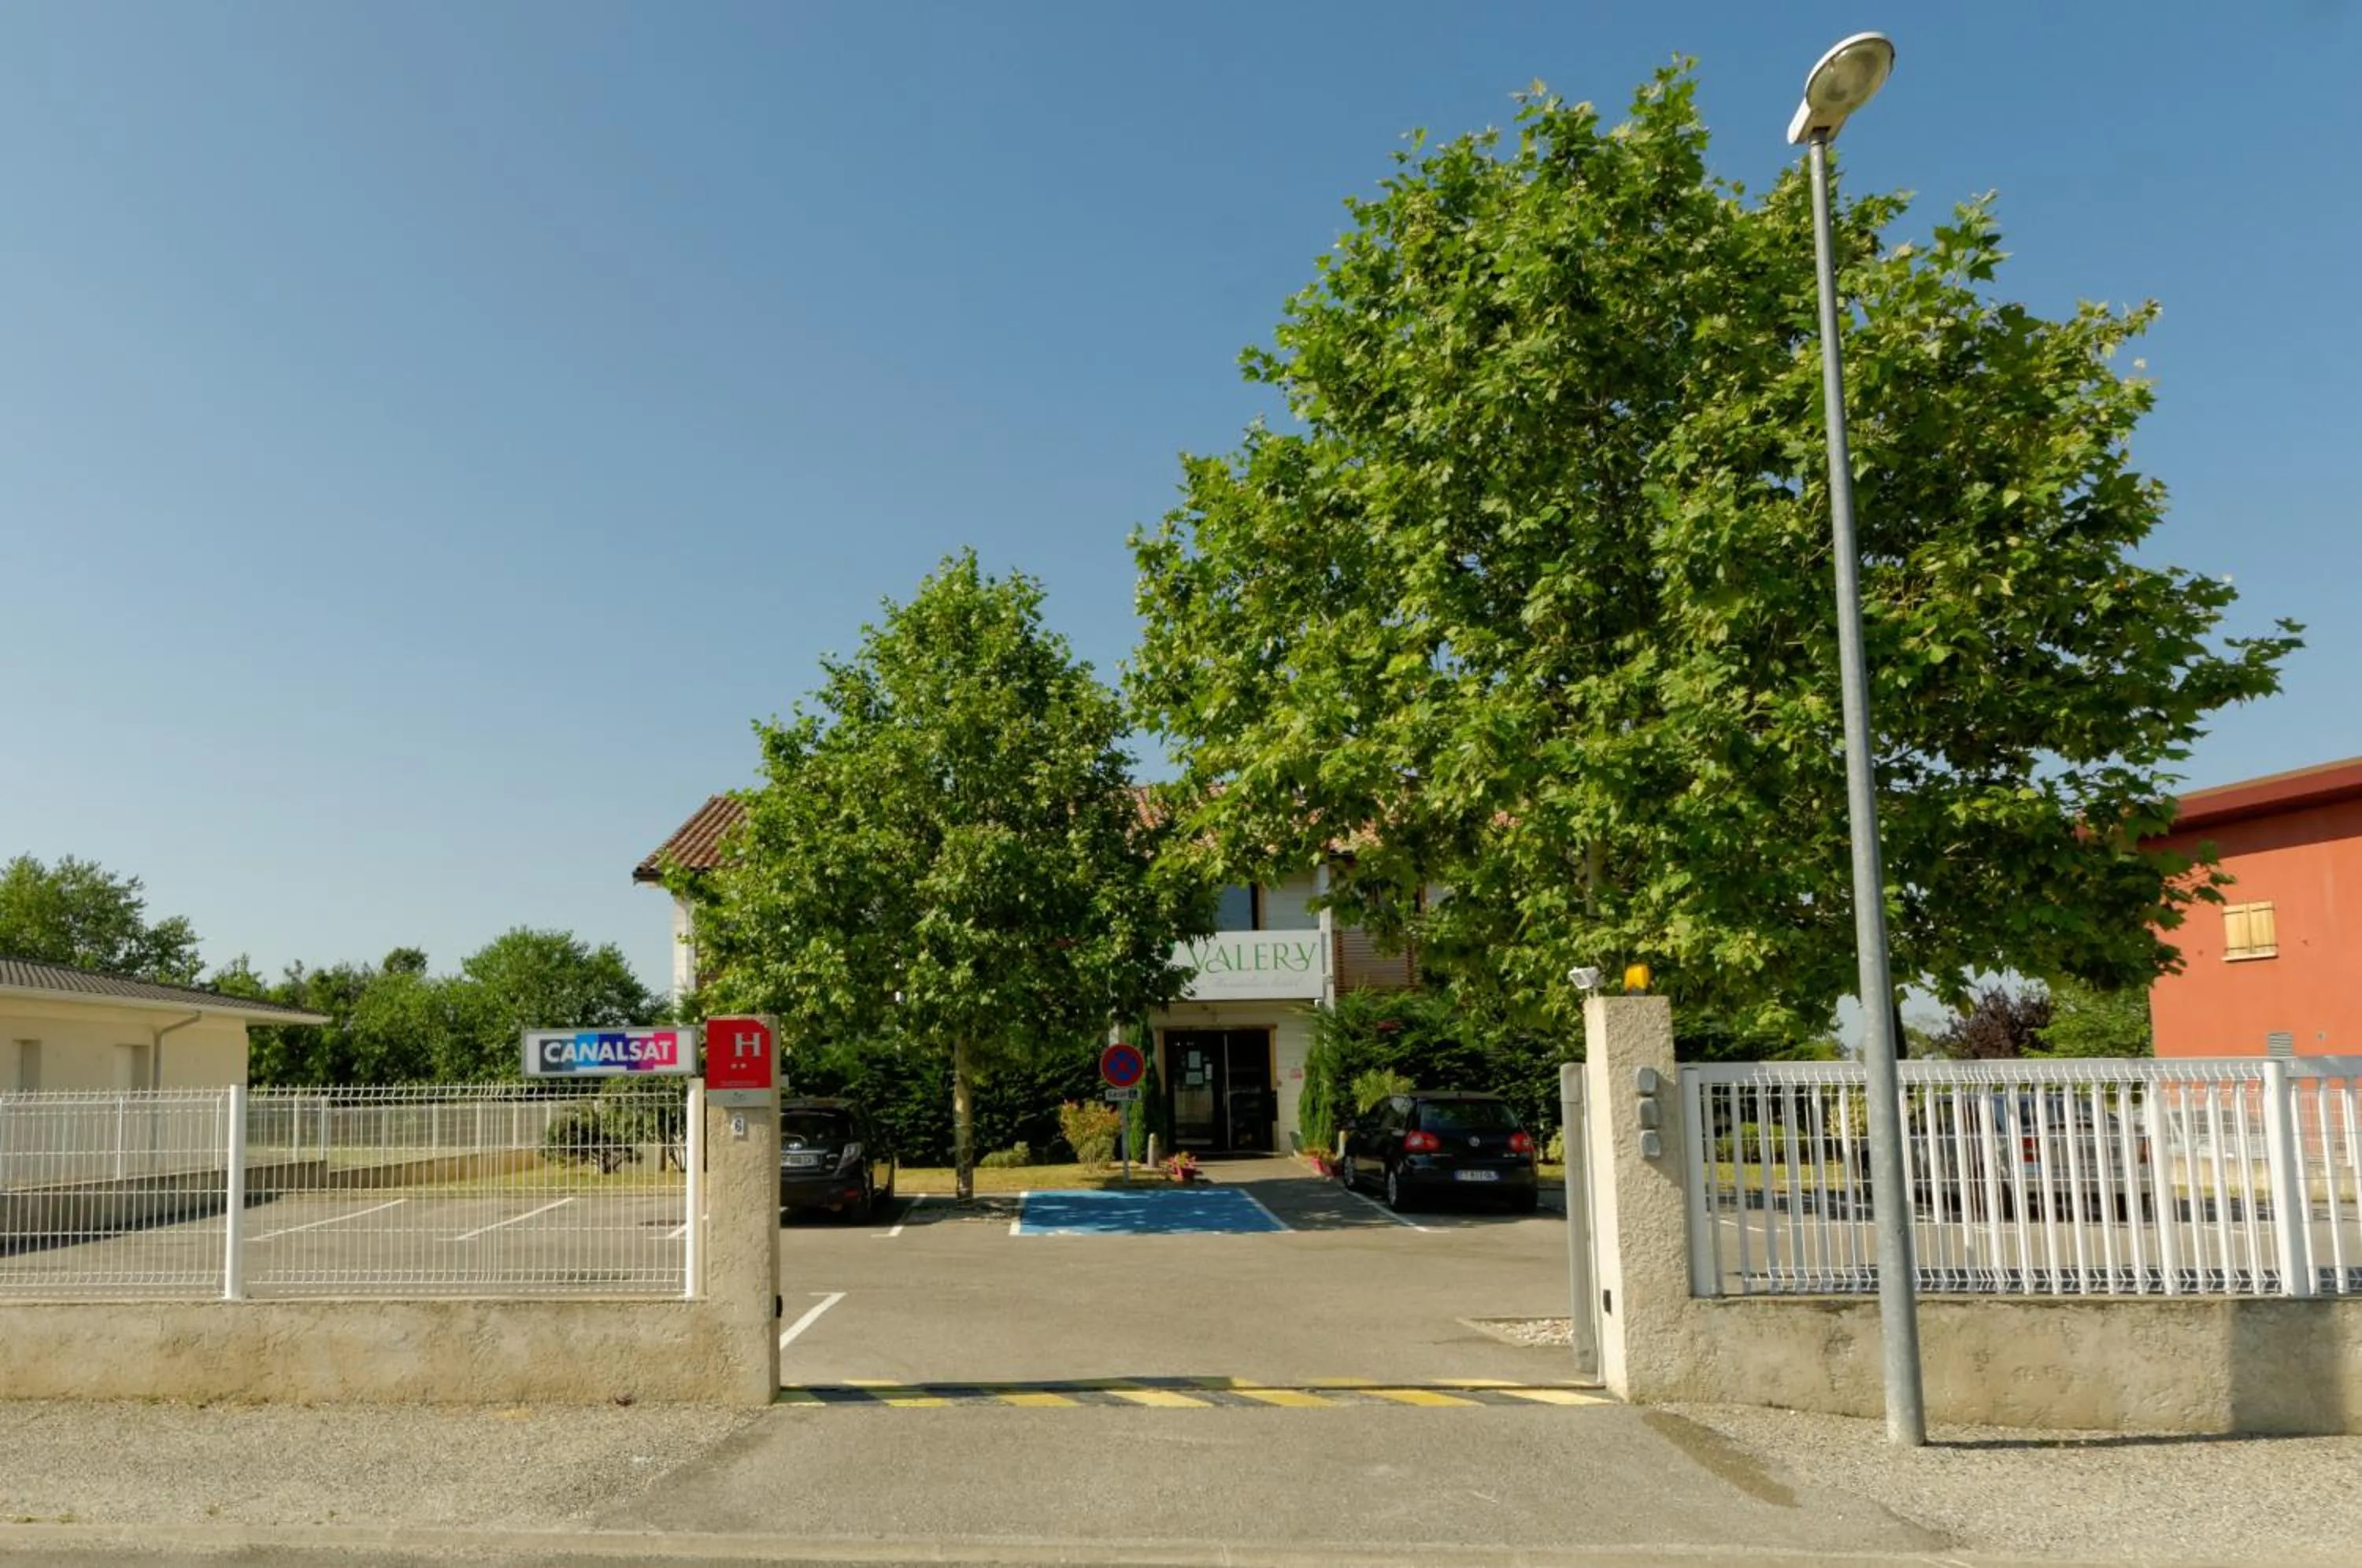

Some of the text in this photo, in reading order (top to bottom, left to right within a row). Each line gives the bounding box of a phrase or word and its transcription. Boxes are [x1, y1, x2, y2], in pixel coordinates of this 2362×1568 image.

[1186, 941, 1317, 974] VALERY
[543, 1039, 672, 1063] CANALSAT
[735, 1032, 761, 1057] H
